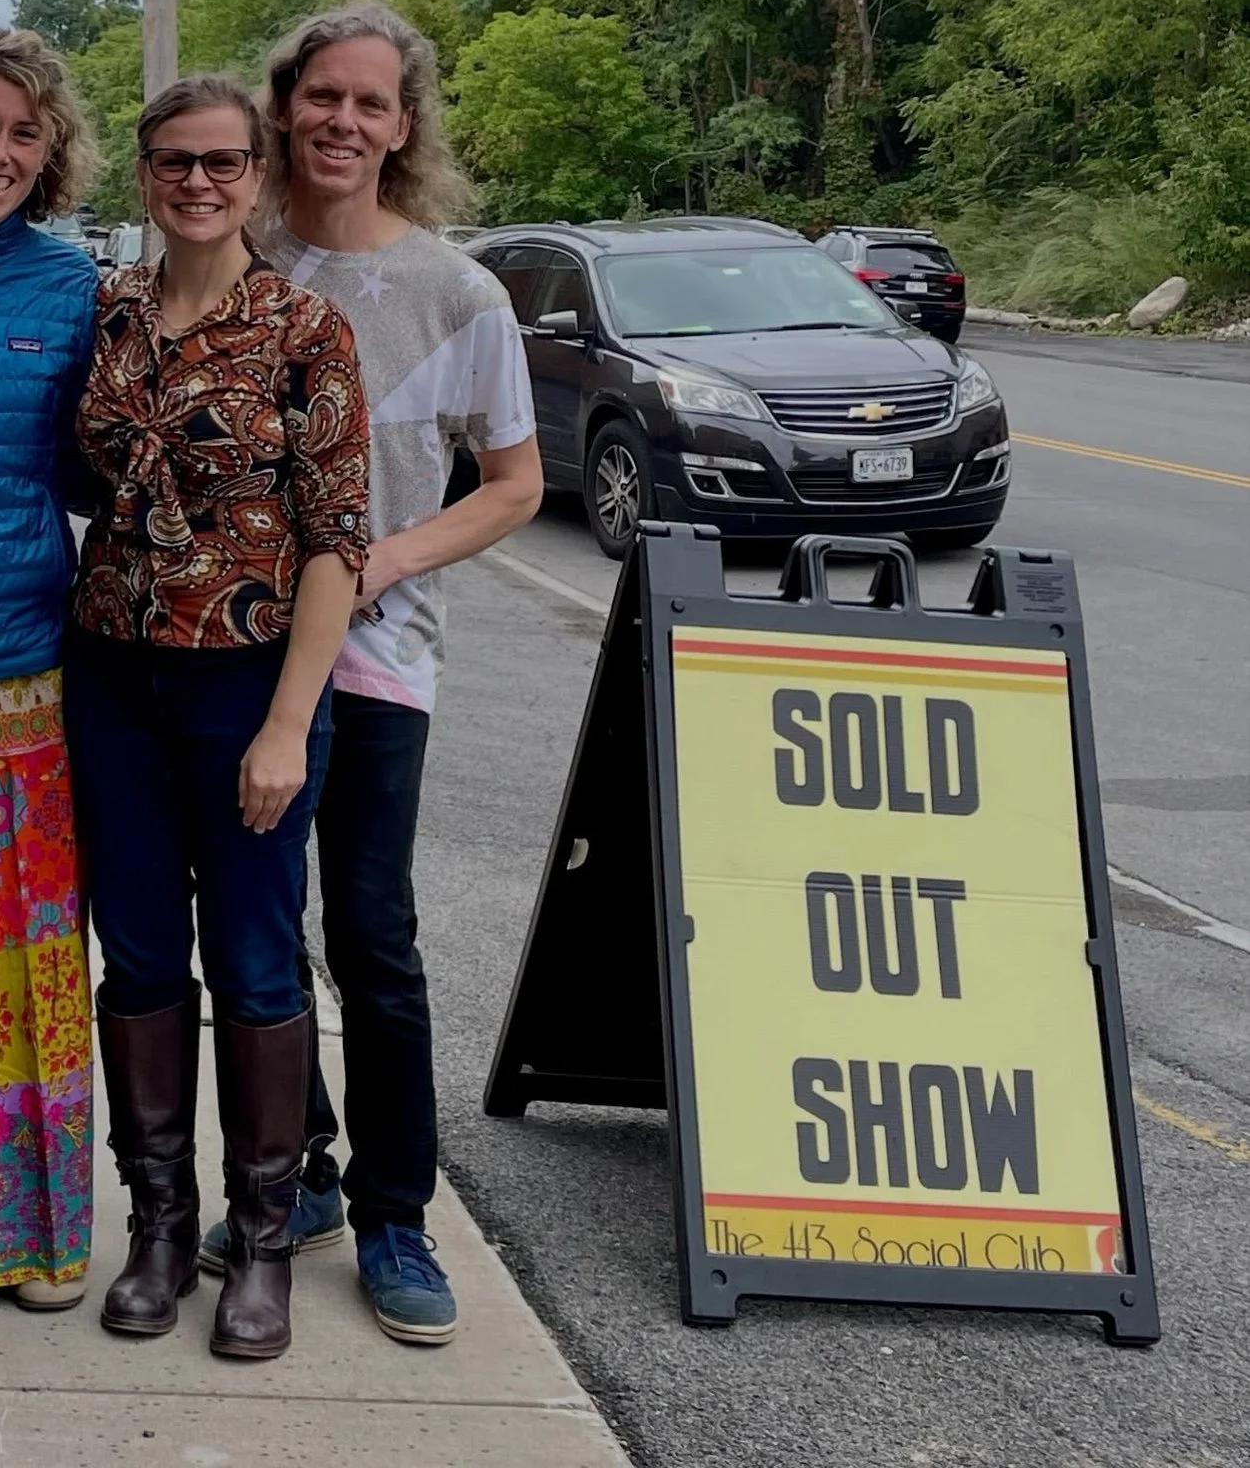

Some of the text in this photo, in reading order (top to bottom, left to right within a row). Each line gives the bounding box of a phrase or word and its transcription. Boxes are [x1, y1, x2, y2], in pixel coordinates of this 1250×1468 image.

[772, 688, 980, 816] SOLD
[805, 871, 967, 999] OUT
[792, 1057, 1040, 1195] SHOW
[709, 1219, 1065, 1272] The 443 Social Club
